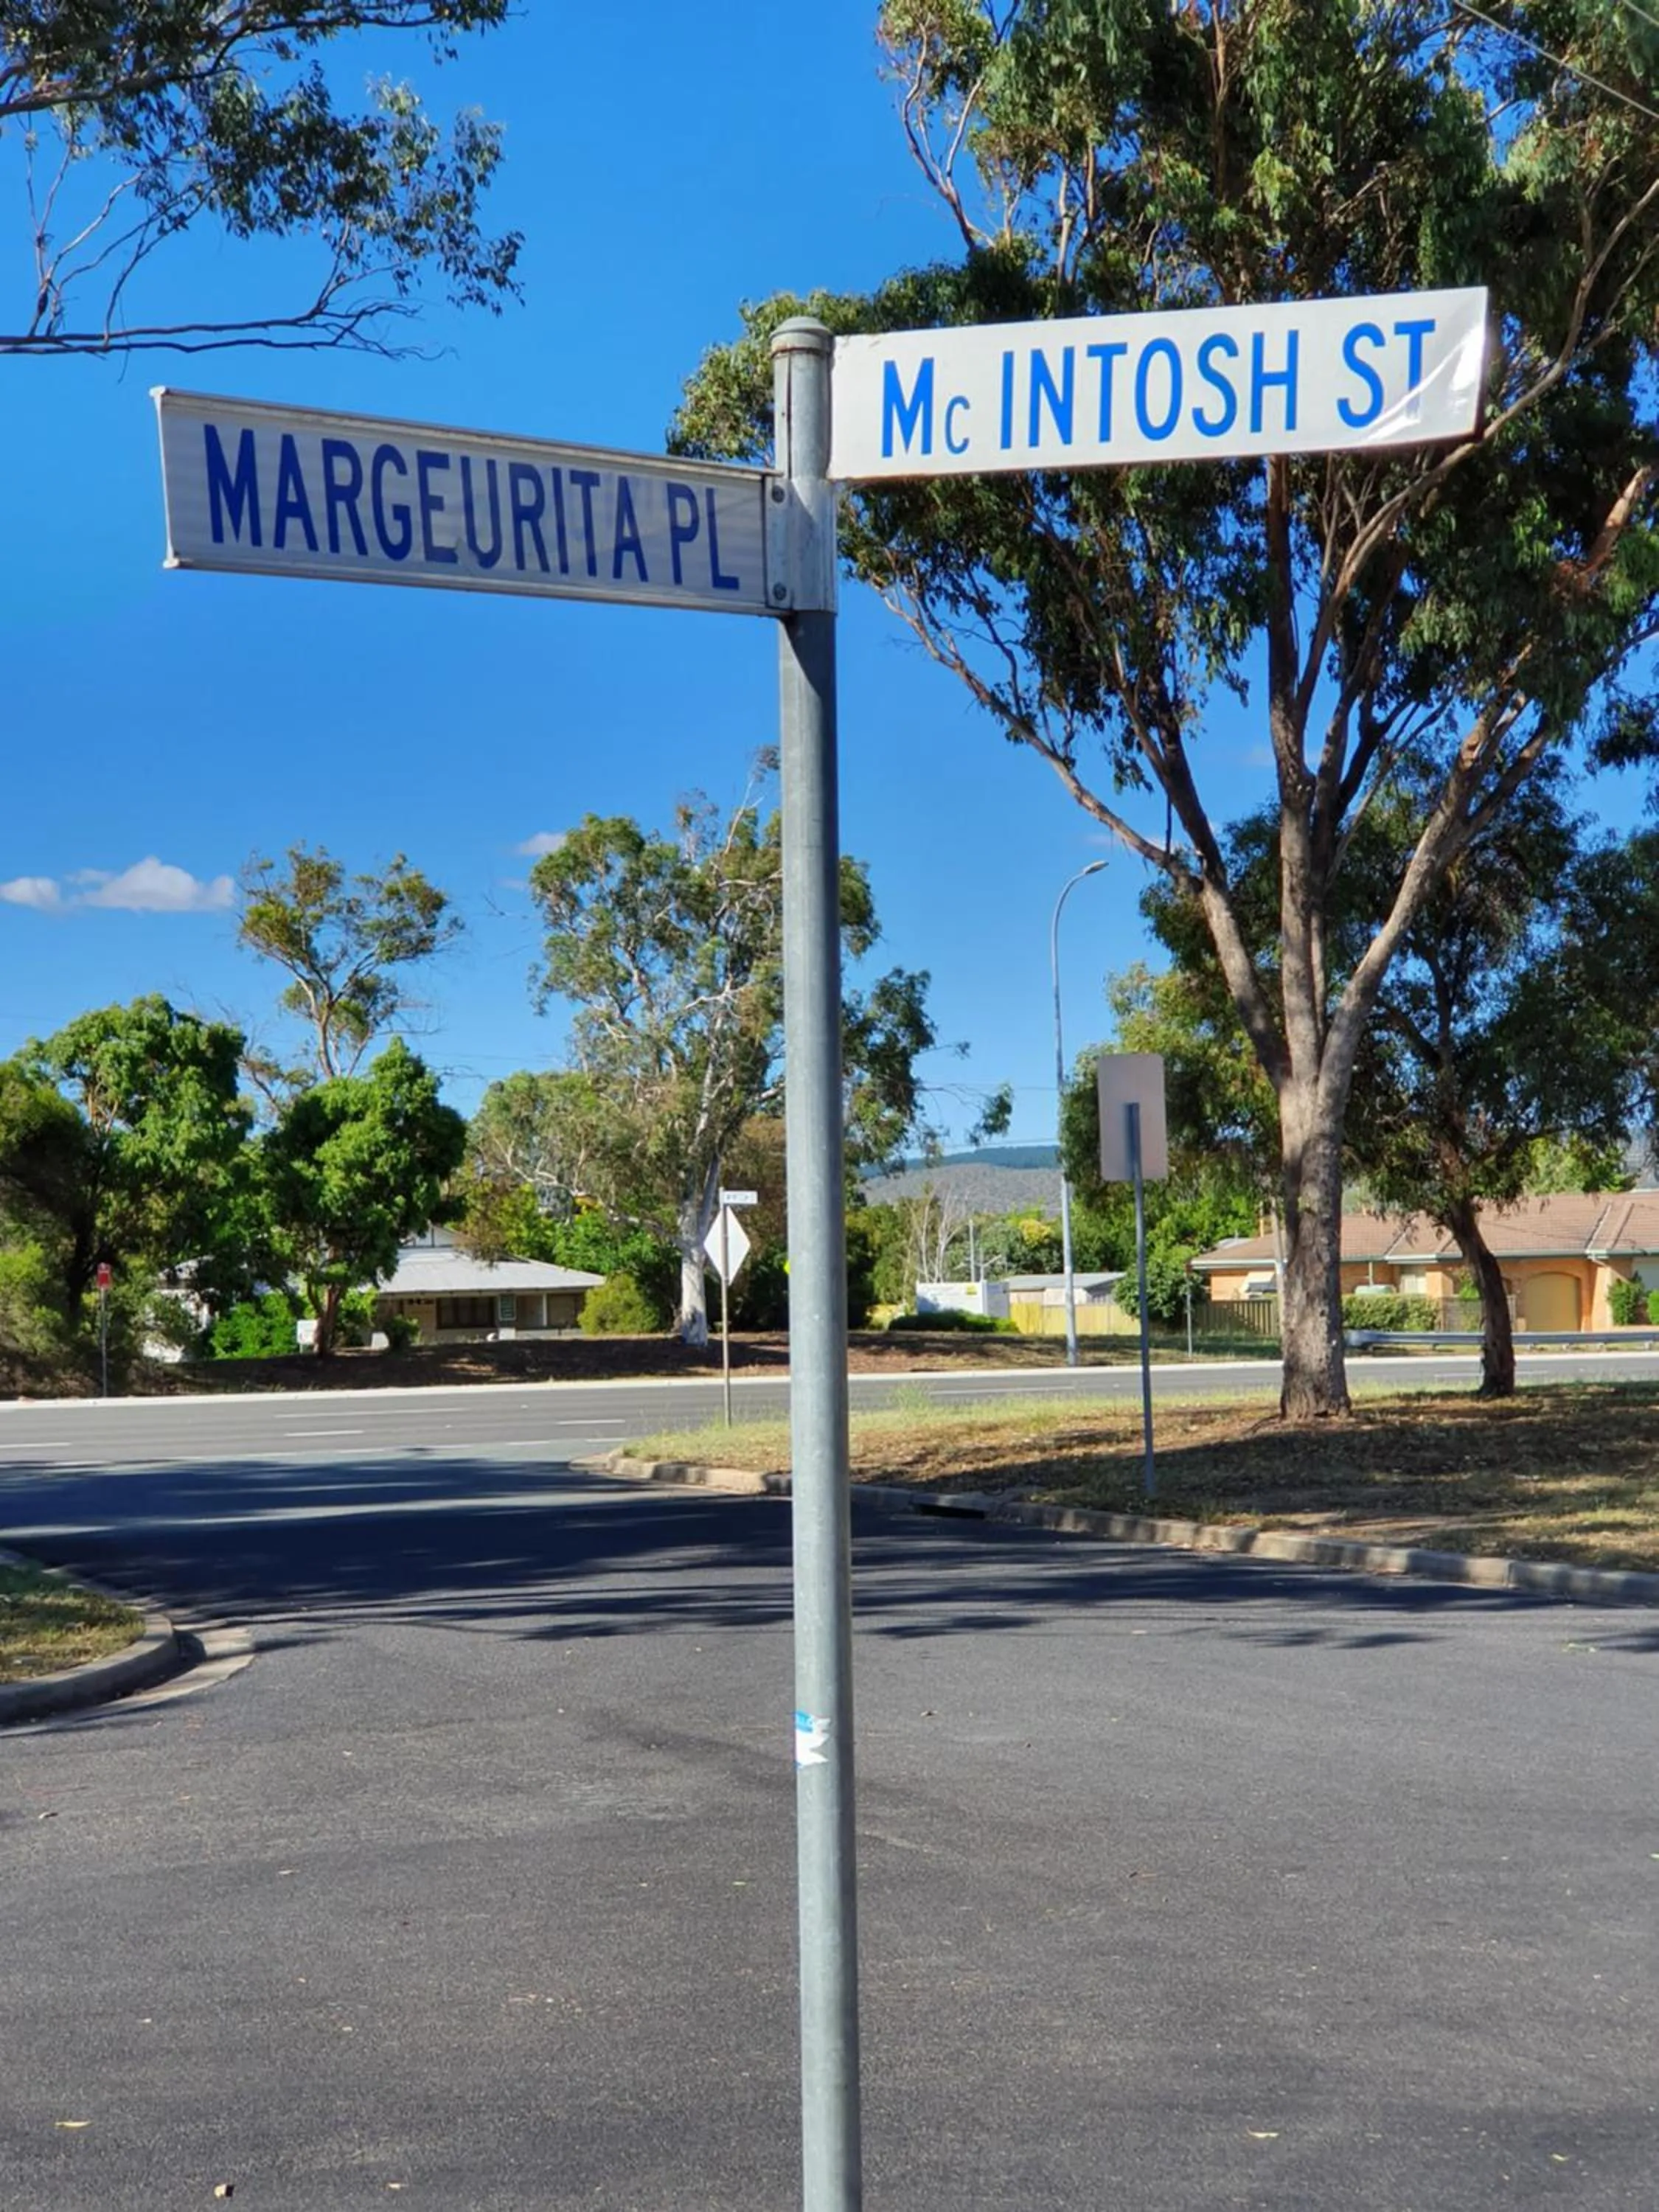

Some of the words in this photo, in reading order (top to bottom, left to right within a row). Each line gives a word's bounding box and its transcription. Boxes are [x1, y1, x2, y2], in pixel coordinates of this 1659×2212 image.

[1000, 330, 1298, 449] INTOSH
[1337, 319, 1436, 428] ST
[204, 424, 649, 582] MARGEURITA
[667, 483, 739, 589] PL
